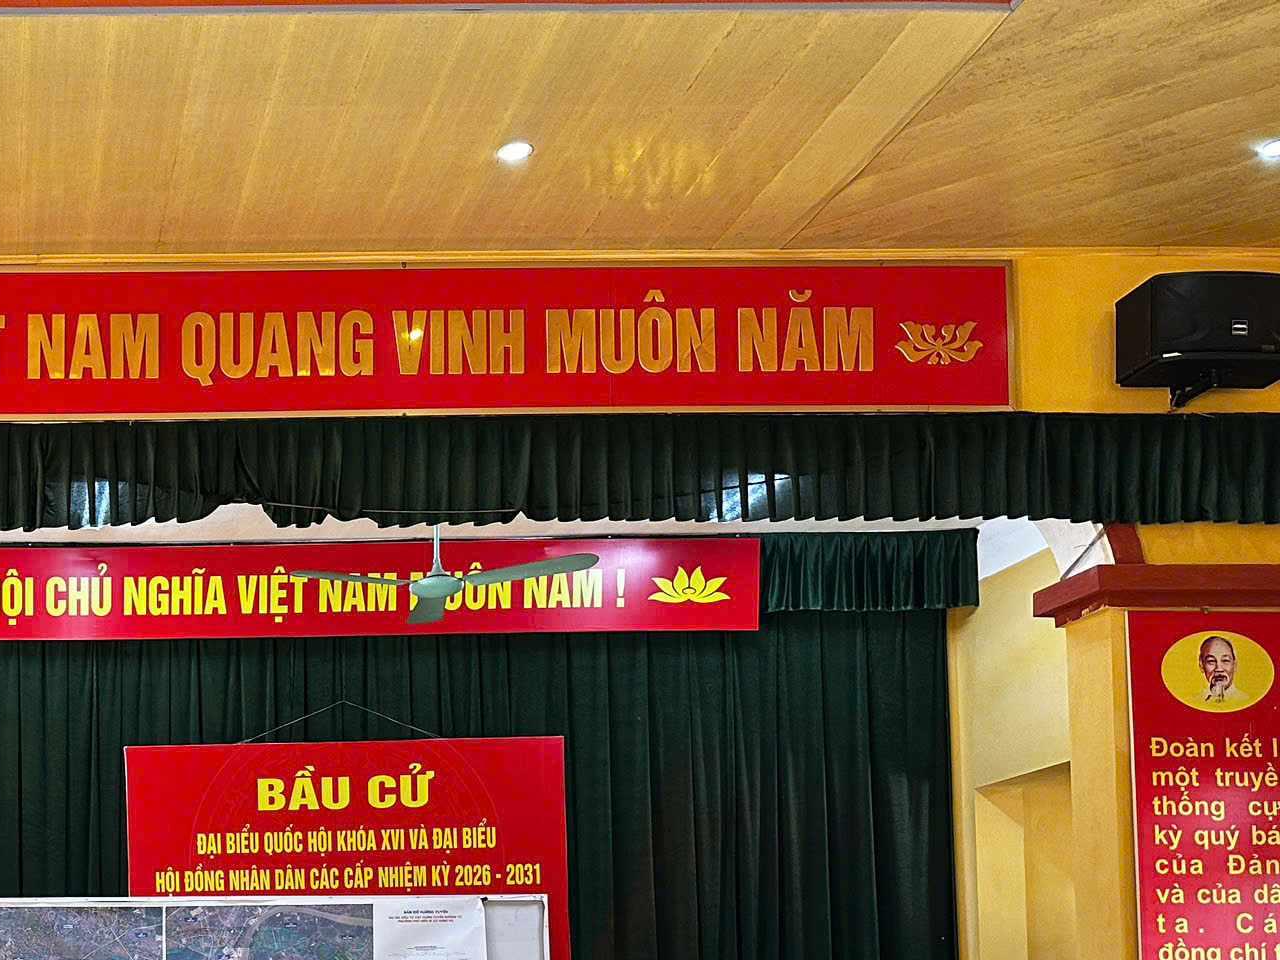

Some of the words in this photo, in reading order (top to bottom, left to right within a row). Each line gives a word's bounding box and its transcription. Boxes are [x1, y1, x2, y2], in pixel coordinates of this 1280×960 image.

[26, 313, 160, 380] NAM
[181, 309, 374, 387] QUANG
[391, 309, 525, 376] VINH
[544, 288, 717, 375] MUÔN
[736, 289, 875, 373] NĂM
[45, 562, 113, 617] CHỦ
[123, 567, 228, 617] NGHĨA
[236, 565, 309, 624] VIỆT
[318, 571, 398, 613] NAM
[409, 561, 512, 612] UÔN
[615, 567, 627, 609] !
[1149, 736, 1215, 758] Đoàn
[1225, 732, 1263, 759] kết
[256, 765, 351, 812] BẦU
[367, 762, 436, 809] CỬ
[1151, 765, 1200, 792] một
[1151, 790, 1226, 822] thống
[196, 832, 222, 859] ĐẠI
[225, 823, 260, 855] BIỂU
[263, 823, 304, 856] QUỐC
[307, 825, 333, 858] HỘI
[336, 824, 378, 852] KHÓA
[380, 828, 406, 851] XVI
[408, 823, 430, 850] VÀ
[431, 827, 459, 856] ĐẠI
[461, 817, 497, 849] BIỂU
[1154, 823, 1183, 851] kỳ
[1193, 824, 1240, 851] quý
[155, 866, 181, 897] HỘI
[183, 862, 225, 893] ĐỒNG
[228, 864, 271, 892] NHÂN
[274, 863, 306, 891] DÂN
[309, 862, 340, 890] CÁC
[343, 859, 374, 889] CẤP
[377, 860, 428, 893] NHIỆM
[431, 860, 451, 887] KỲ
[454, 863, 492, 887] 2026
[505, 862, 541, 886] 2031
[1154, 852, 1204, 875] của
[1155, 882, 1185, 905] và
[1196, 882, 1242, 905] của
[1156, 913, 1205, 934] ta.
